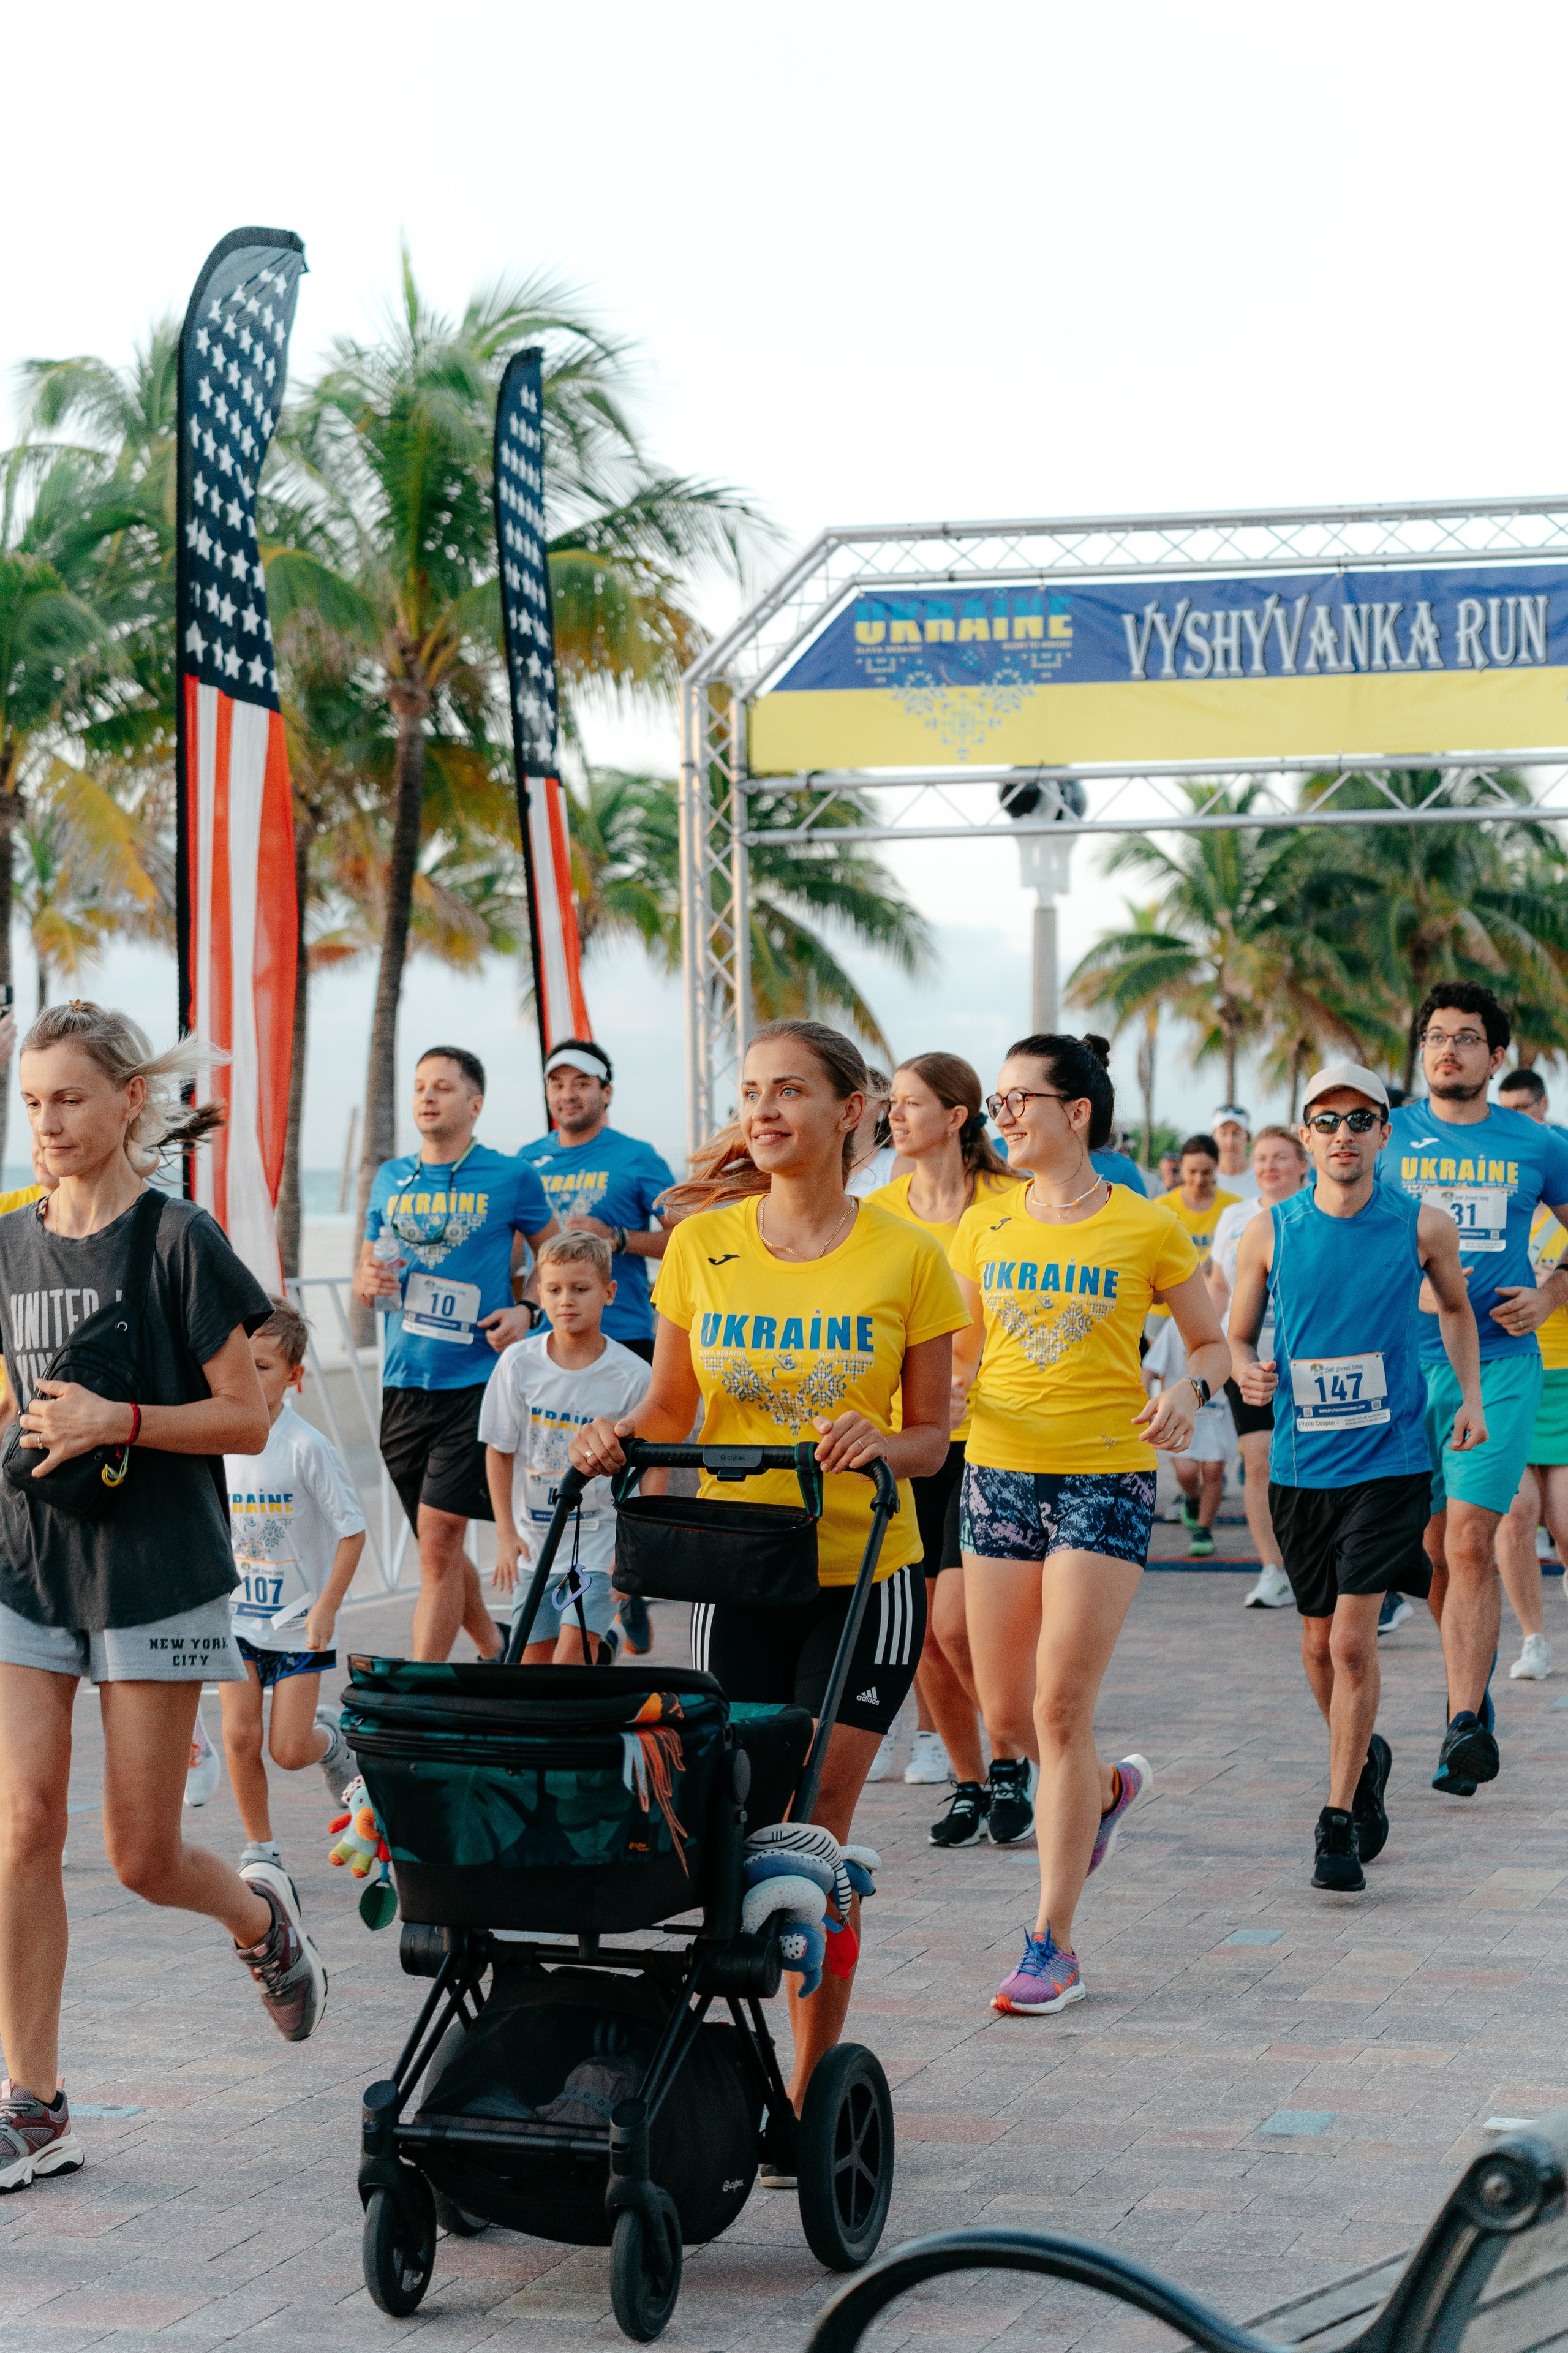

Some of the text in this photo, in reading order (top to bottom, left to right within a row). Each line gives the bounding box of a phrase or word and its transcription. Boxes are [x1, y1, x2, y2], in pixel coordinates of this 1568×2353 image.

[1122, 594, 1548, 680] VYSHYVANKA RUN
[540, 1169, 609, 1192] KRAINE
[1450, 1203, 1476, 1226] 31
[431, 1293, 455, 1316] 10
[1314, 1372, 1363, 1402] 147
[227, 1488, 294, 1513] RAINE
[243, 1576, 284, 1604] 107
[149, 1637, 184, 1650] NEW
[173, 1655, 209, 1666] CITY
[856, 1695, 880, 1705] adidas
